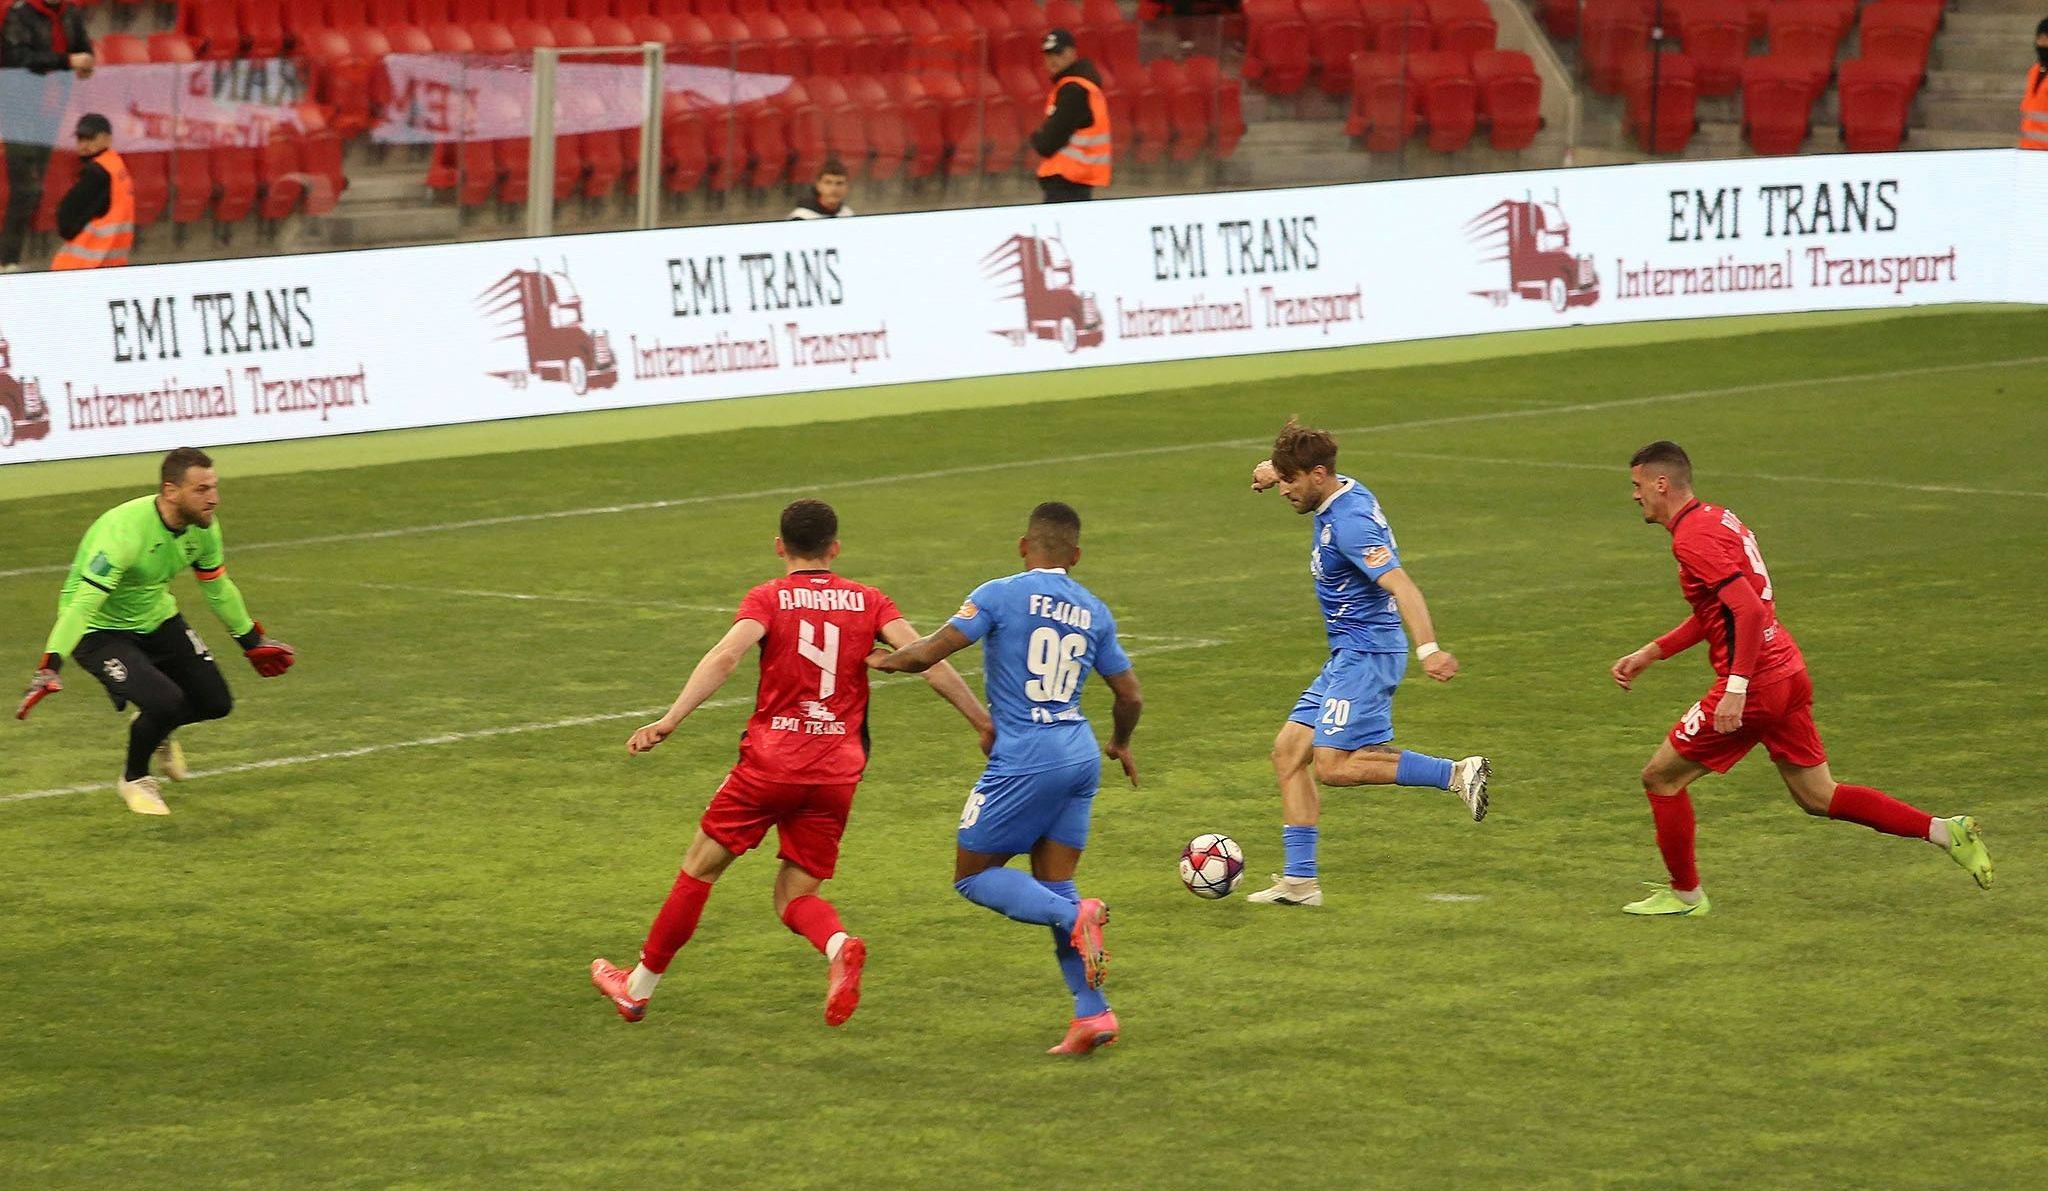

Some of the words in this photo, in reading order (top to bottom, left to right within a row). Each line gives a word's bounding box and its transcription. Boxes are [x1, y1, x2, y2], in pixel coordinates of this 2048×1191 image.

[1668, 187, 1742, 242] EMI
[1759, 179, 1898, 237] TRANS
[1151, 222, 1207, 280] EMI
[1218, 215, 1319, 275] TRANS
[1616, 249, 1793, 300] International
[1805, 245, 1957, 294] Transport
[667, 255, 731, 316] EMI
[739, 247, 844, 311] TRANS
[1116, 287, 1252, 339] International
[1260, 282, 1364, 335] Transport
[108, 296, 181, 362] EMI
[193, 286, 315, 356] TRANS
[630, 323, 780, 380] International
[785, 319, 891, 374] Transport
[65, 367, 237, 431] International
[245, 361, 370, 422] Transport
[797, 618, 841, 701] 4
[1024, 626, 1089, 704] 96
[770, 716, 801, 732] EMI
[1320, 697, 1351, 727] 20
